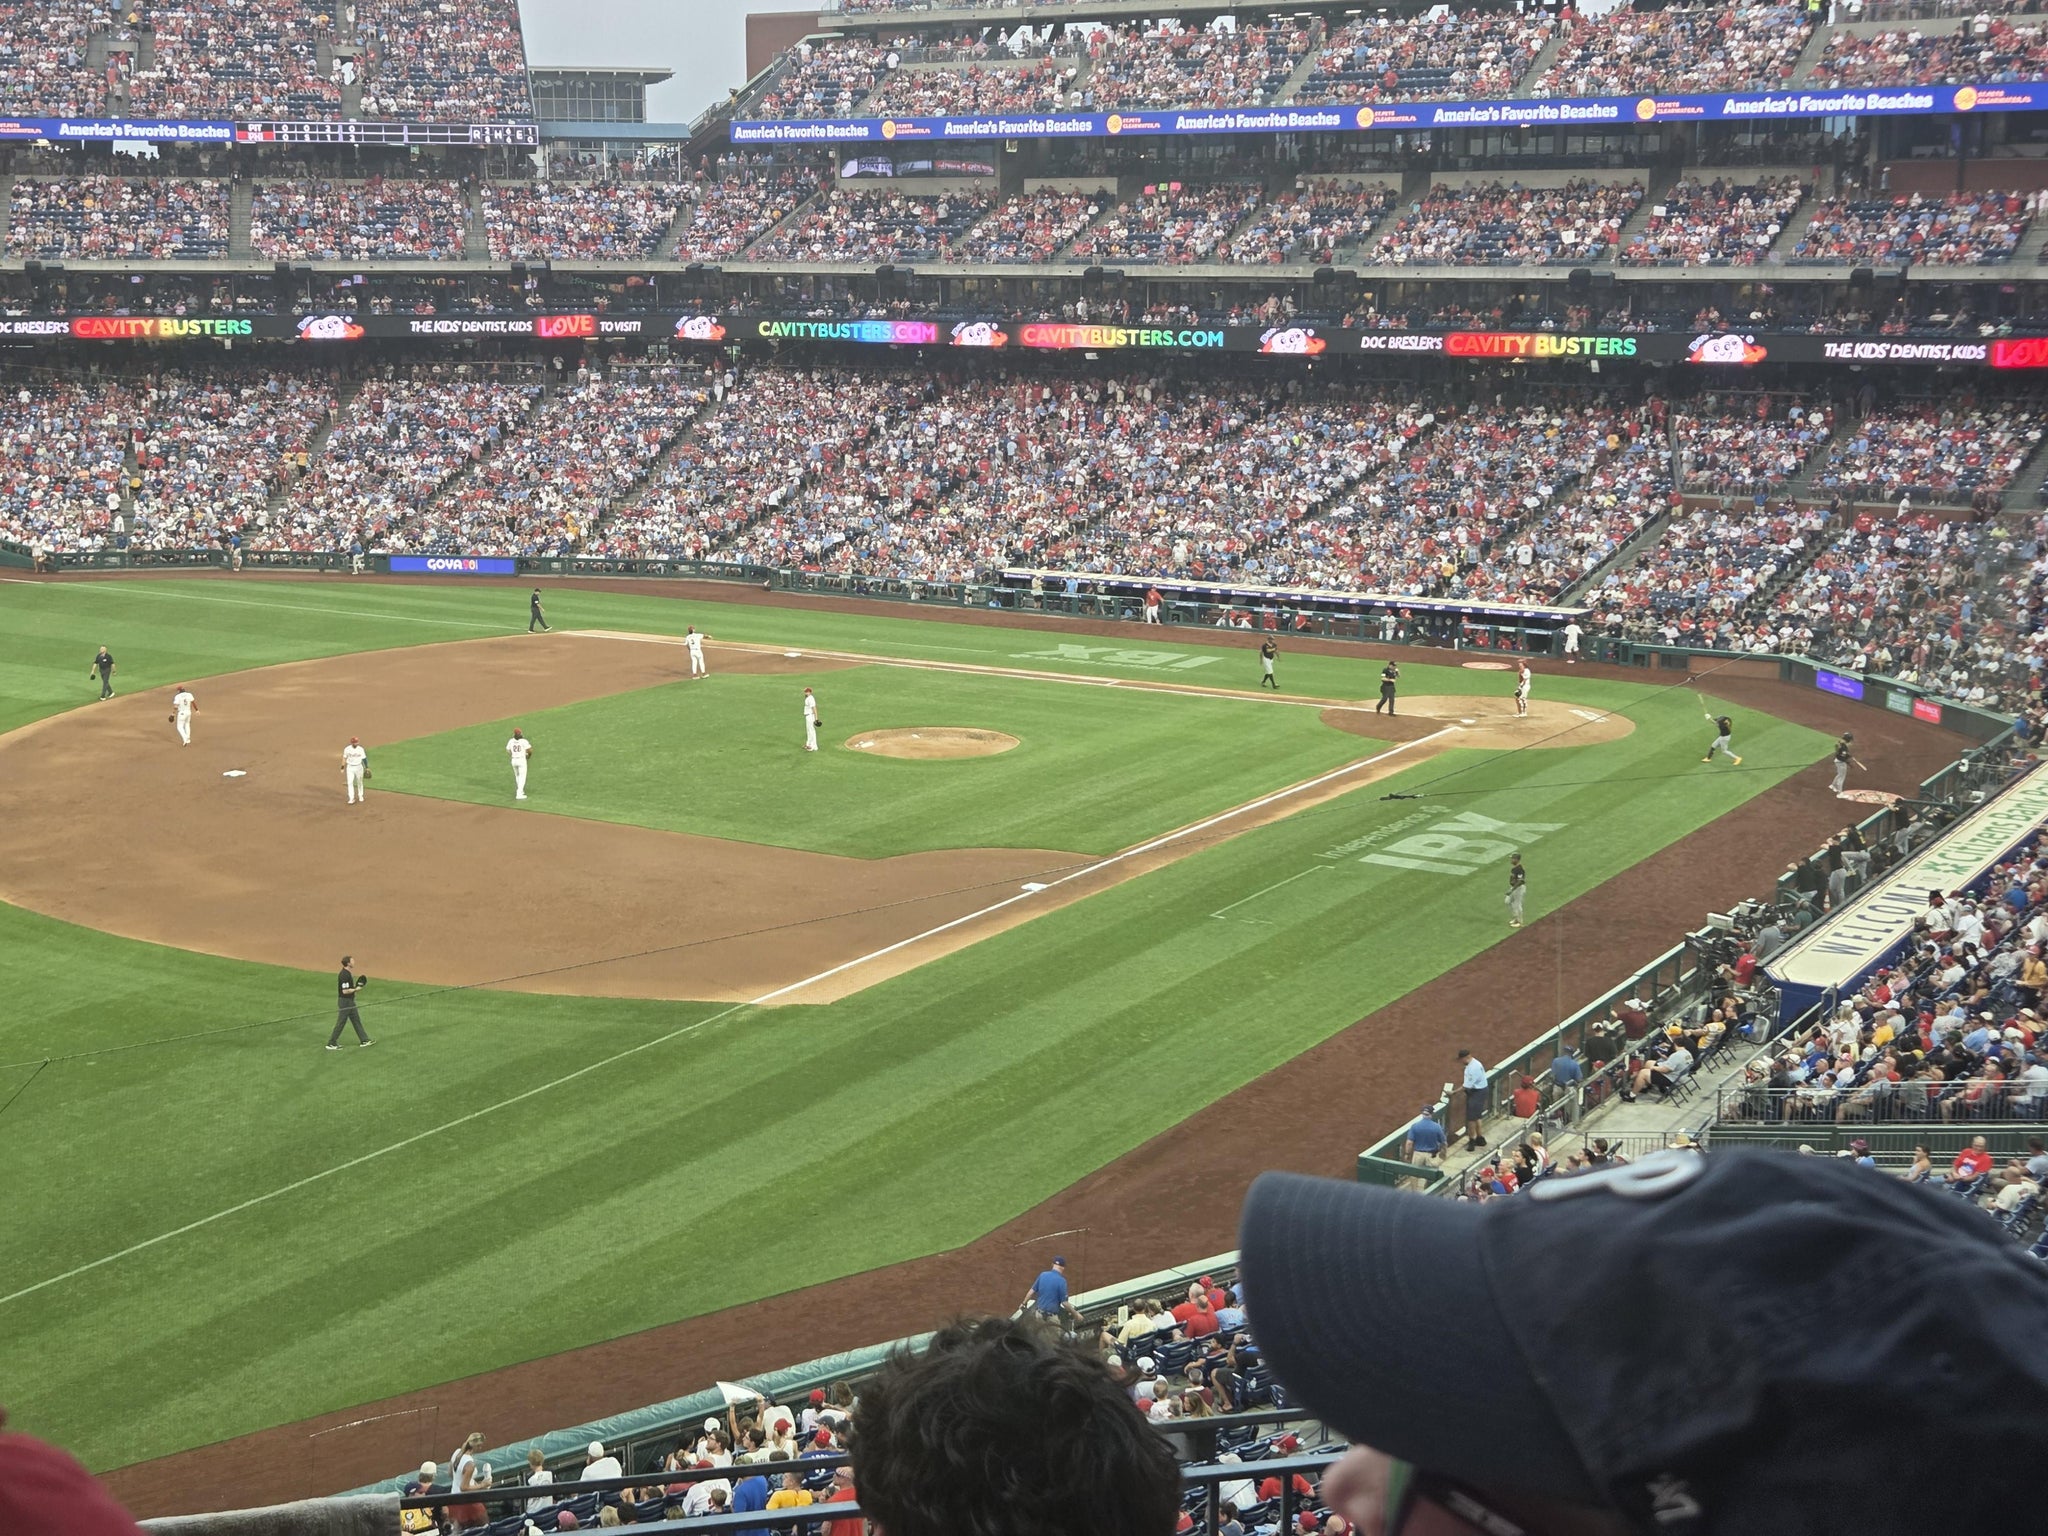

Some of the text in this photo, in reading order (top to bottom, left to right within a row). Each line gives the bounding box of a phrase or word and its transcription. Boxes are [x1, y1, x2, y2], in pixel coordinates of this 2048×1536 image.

[1723, 93, 1933, 114] America's Favorite Beaches
[1176, 112, 1340, 129] America's Favorite Beaches
[1433, 104, 1618, 122] America's Favorite Beaches
[60, 123, 230, 137] America's Favorite Beaches
[248, 124, 262, 132] PIT
[473, 130, 481, 139] R
[494, 130, 502, 139] H
[517, 130, 523, 139] E
[735, 125, 868, 139] America's Favorite Beaches
[945, 121, 997, 134] America's
[999, 119, 1045, 133] Favorite
[1046, 119, 1092, 132] Beaches
[248, 132, 263, 141] PHI
[14, 321, 69, 334] BRESLER'S
[76, 320, 154, 336] CAVITY
[159, 319, 252, 335] BUSTERS
[410, 321, 433, 332] THE
[434, 321, 461, 333] KIDS'
[508, 321, 532, 332] KIDS
[541, 315, 594, 336] LOVE
[600, 321, 613, 331] TO
[759, 321, 937, 341] CAVITYBUSTERS.COM
[1023, 328, 1224, 347] CAVITYBUSTERS.COM
[1361, 336, 1637, 355] DOC BRESLER'S CAVITY BUSTERS
[1825, 343, 1853, 357] THE
[1853, 343, 1890, 358] KIDS'
[1952, 345, 1986, 359] KIDS
[1357, 810, 1569, 876] IBX
[1810, 883, 1944, 956] WELCOME
